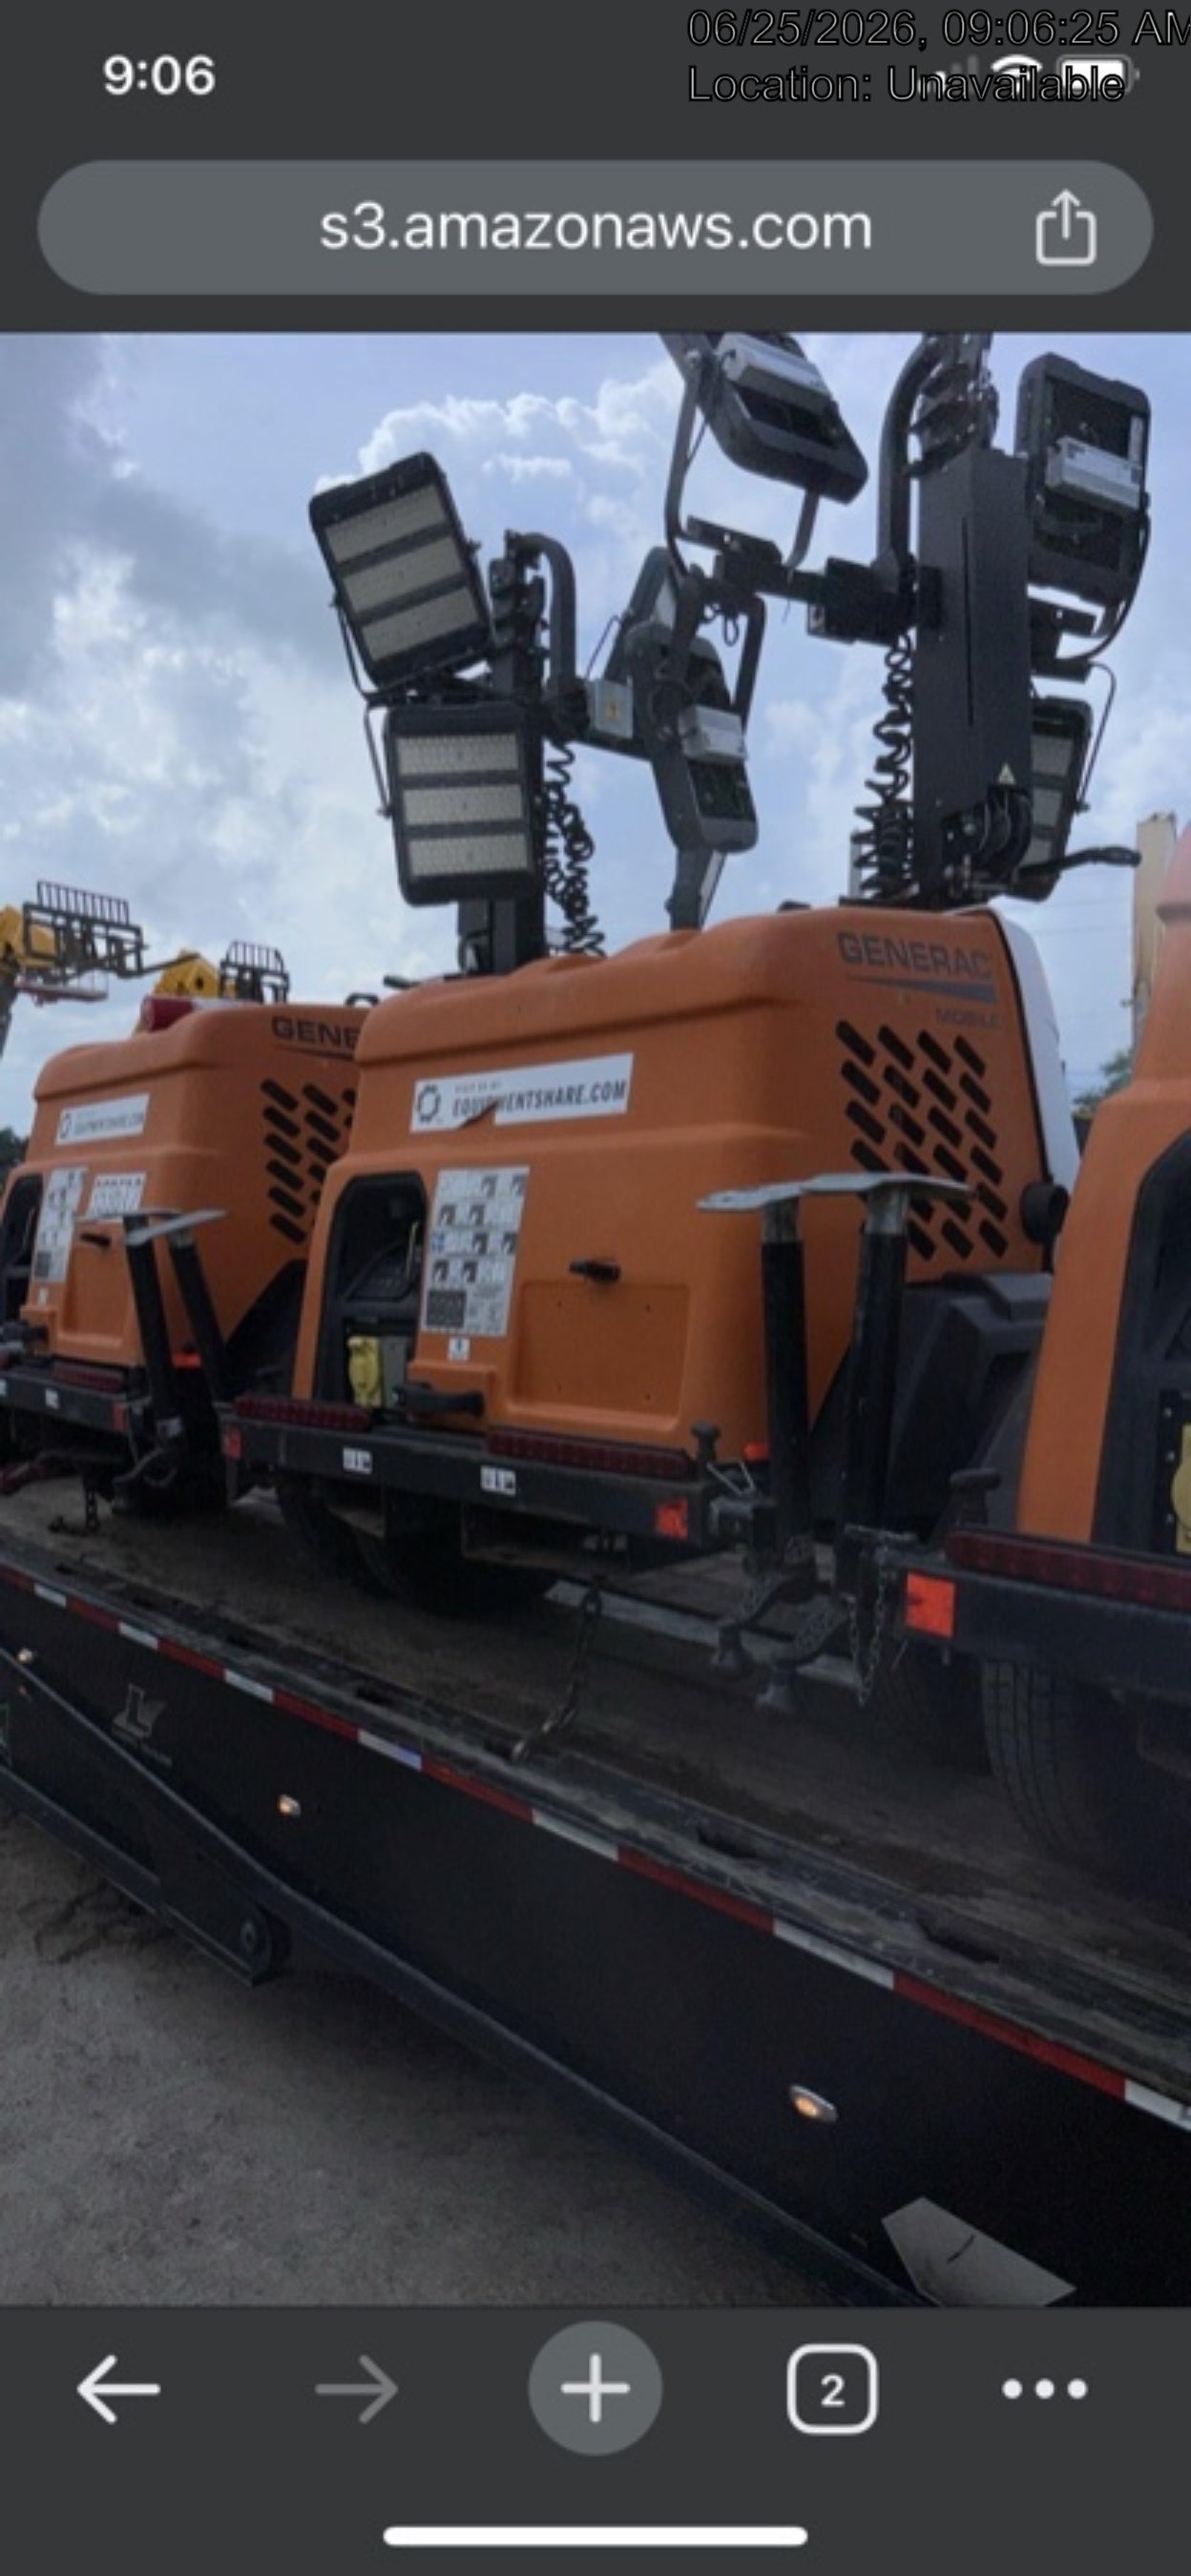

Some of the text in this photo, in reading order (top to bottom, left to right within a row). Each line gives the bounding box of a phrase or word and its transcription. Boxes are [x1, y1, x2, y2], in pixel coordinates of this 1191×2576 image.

[103, 53, 216, 95] 9:06
[320, 200, 873, 250] s3.amazonaws.com
[836, 929, 994, 981] GENERAC
[821, 2373, 846, 2407] 2
